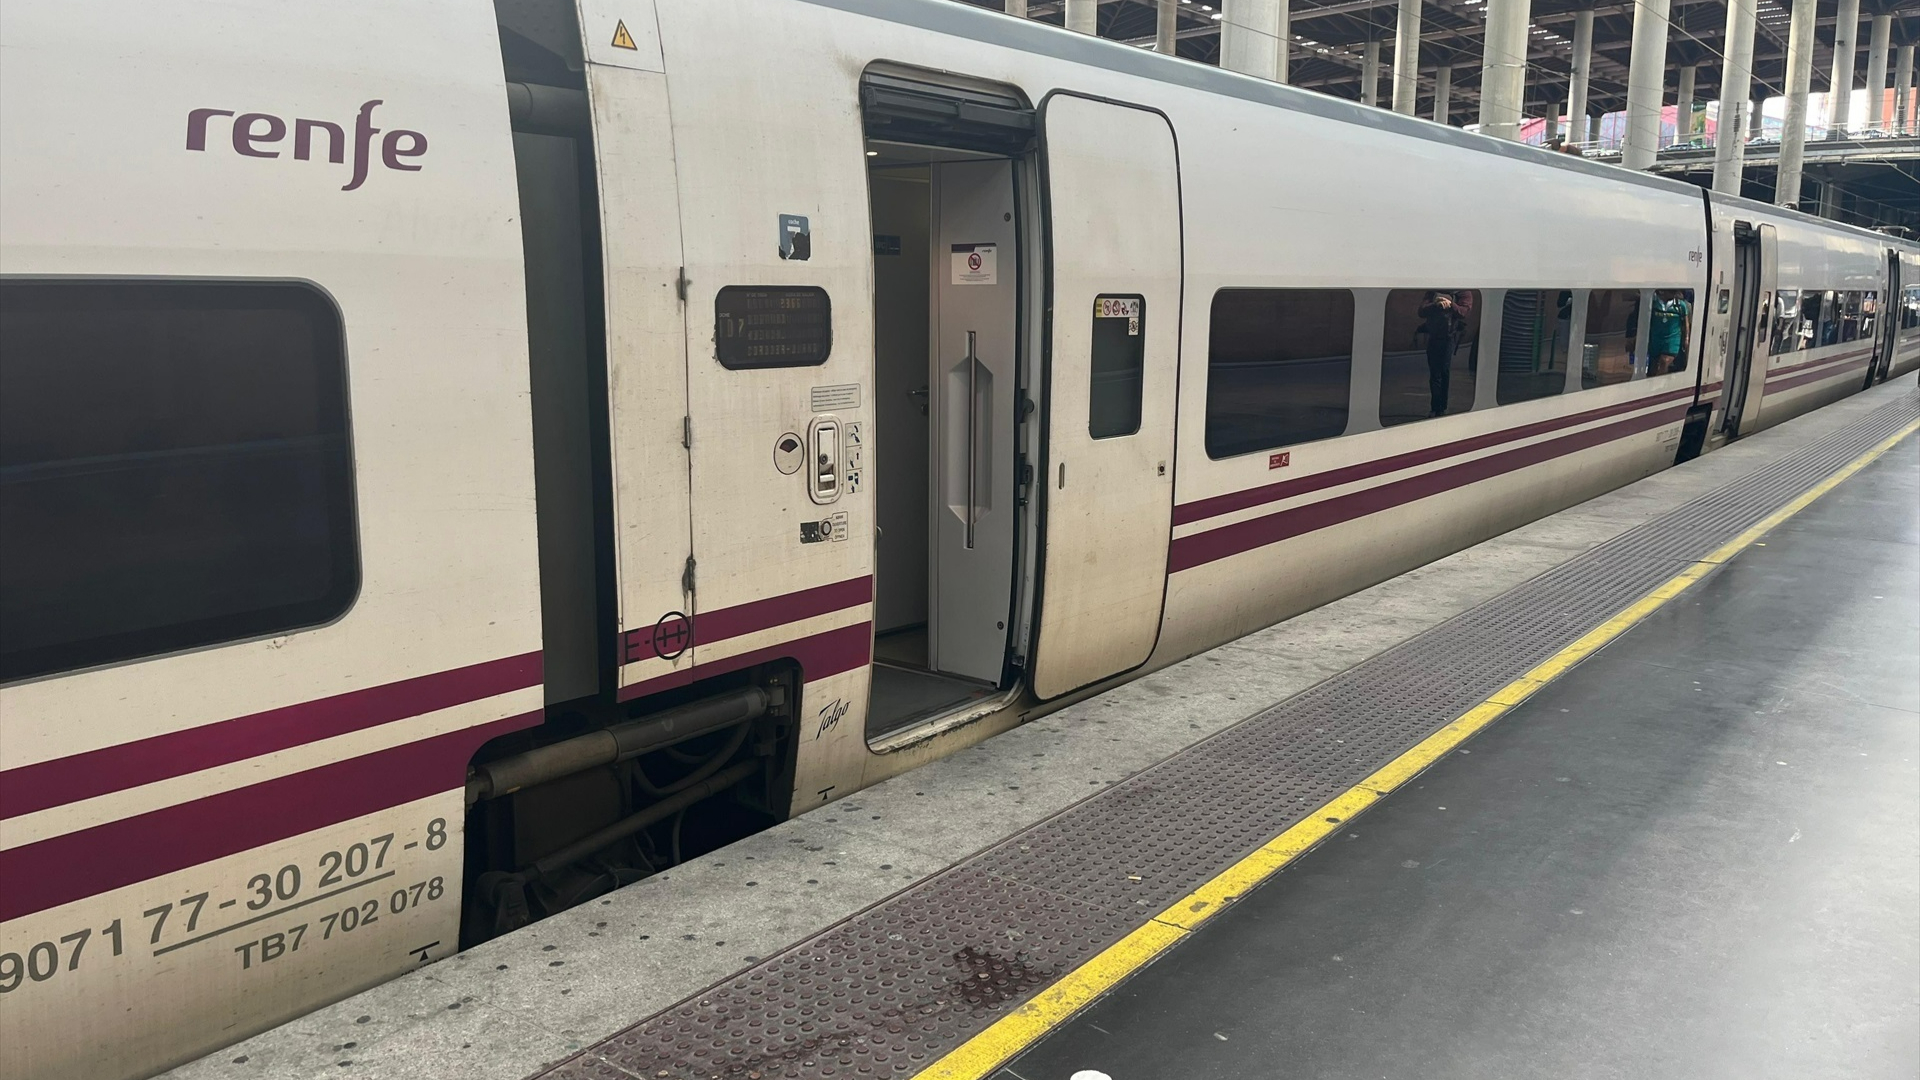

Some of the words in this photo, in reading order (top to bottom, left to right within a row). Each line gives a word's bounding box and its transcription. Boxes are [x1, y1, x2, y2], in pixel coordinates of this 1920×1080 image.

[186, 99, 428, 191] renfe
[1688, 245, 1702, 268] renfe
[815, 698, 851, 741] Talgo
[234, 923, 309, 970] TB7
[319, 899, 379, 941] 702
[389, 876, 444, 915] 078
